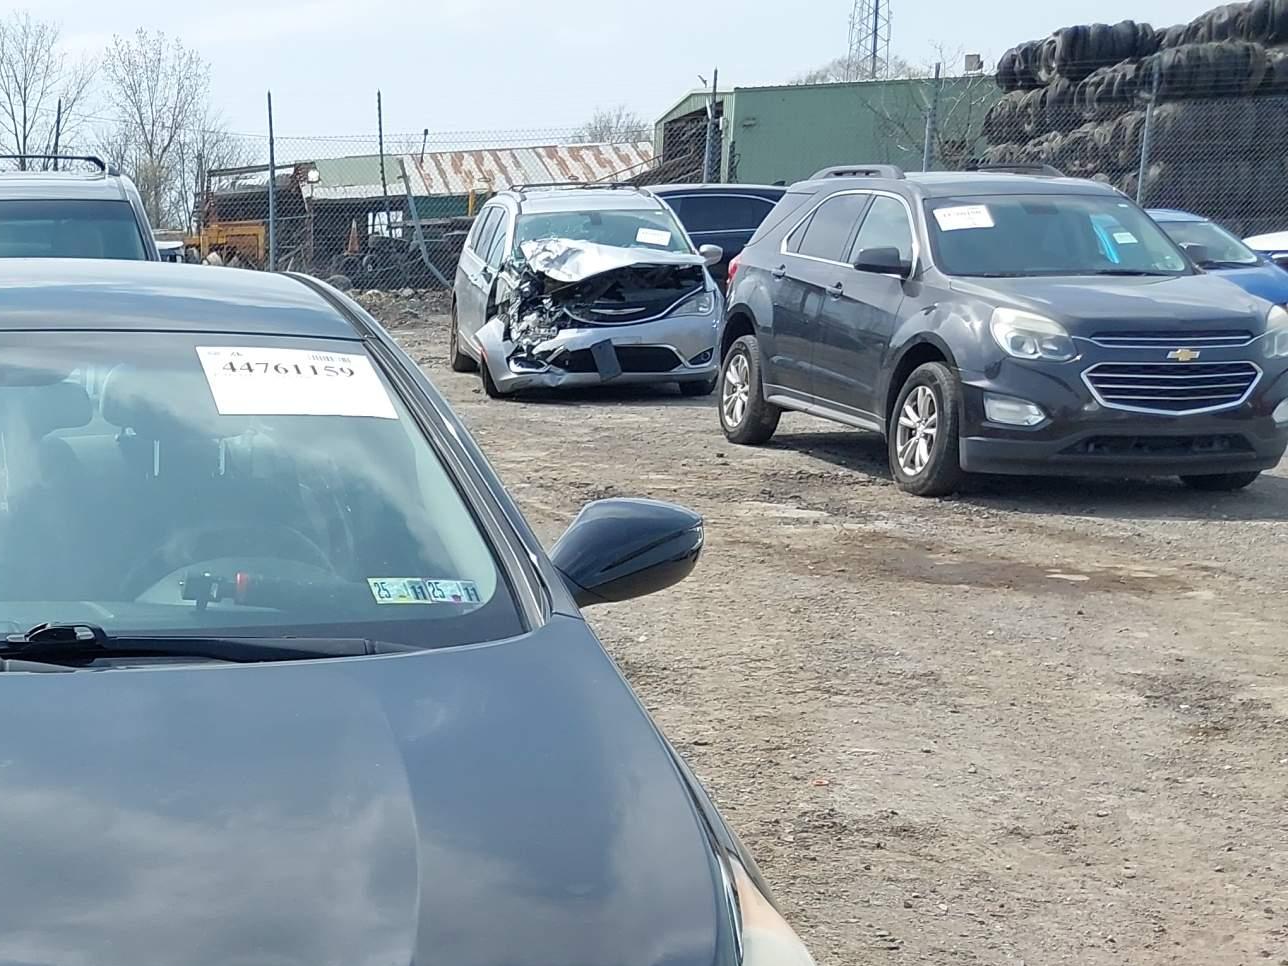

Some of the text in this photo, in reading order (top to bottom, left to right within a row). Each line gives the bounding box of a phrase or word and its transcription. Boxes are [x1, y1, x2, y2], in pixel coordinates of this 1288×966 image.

[222, 361, 355, 377] 44761159
[374, 582, 391, 599] 25
[428, 582, 445, 599] 25
